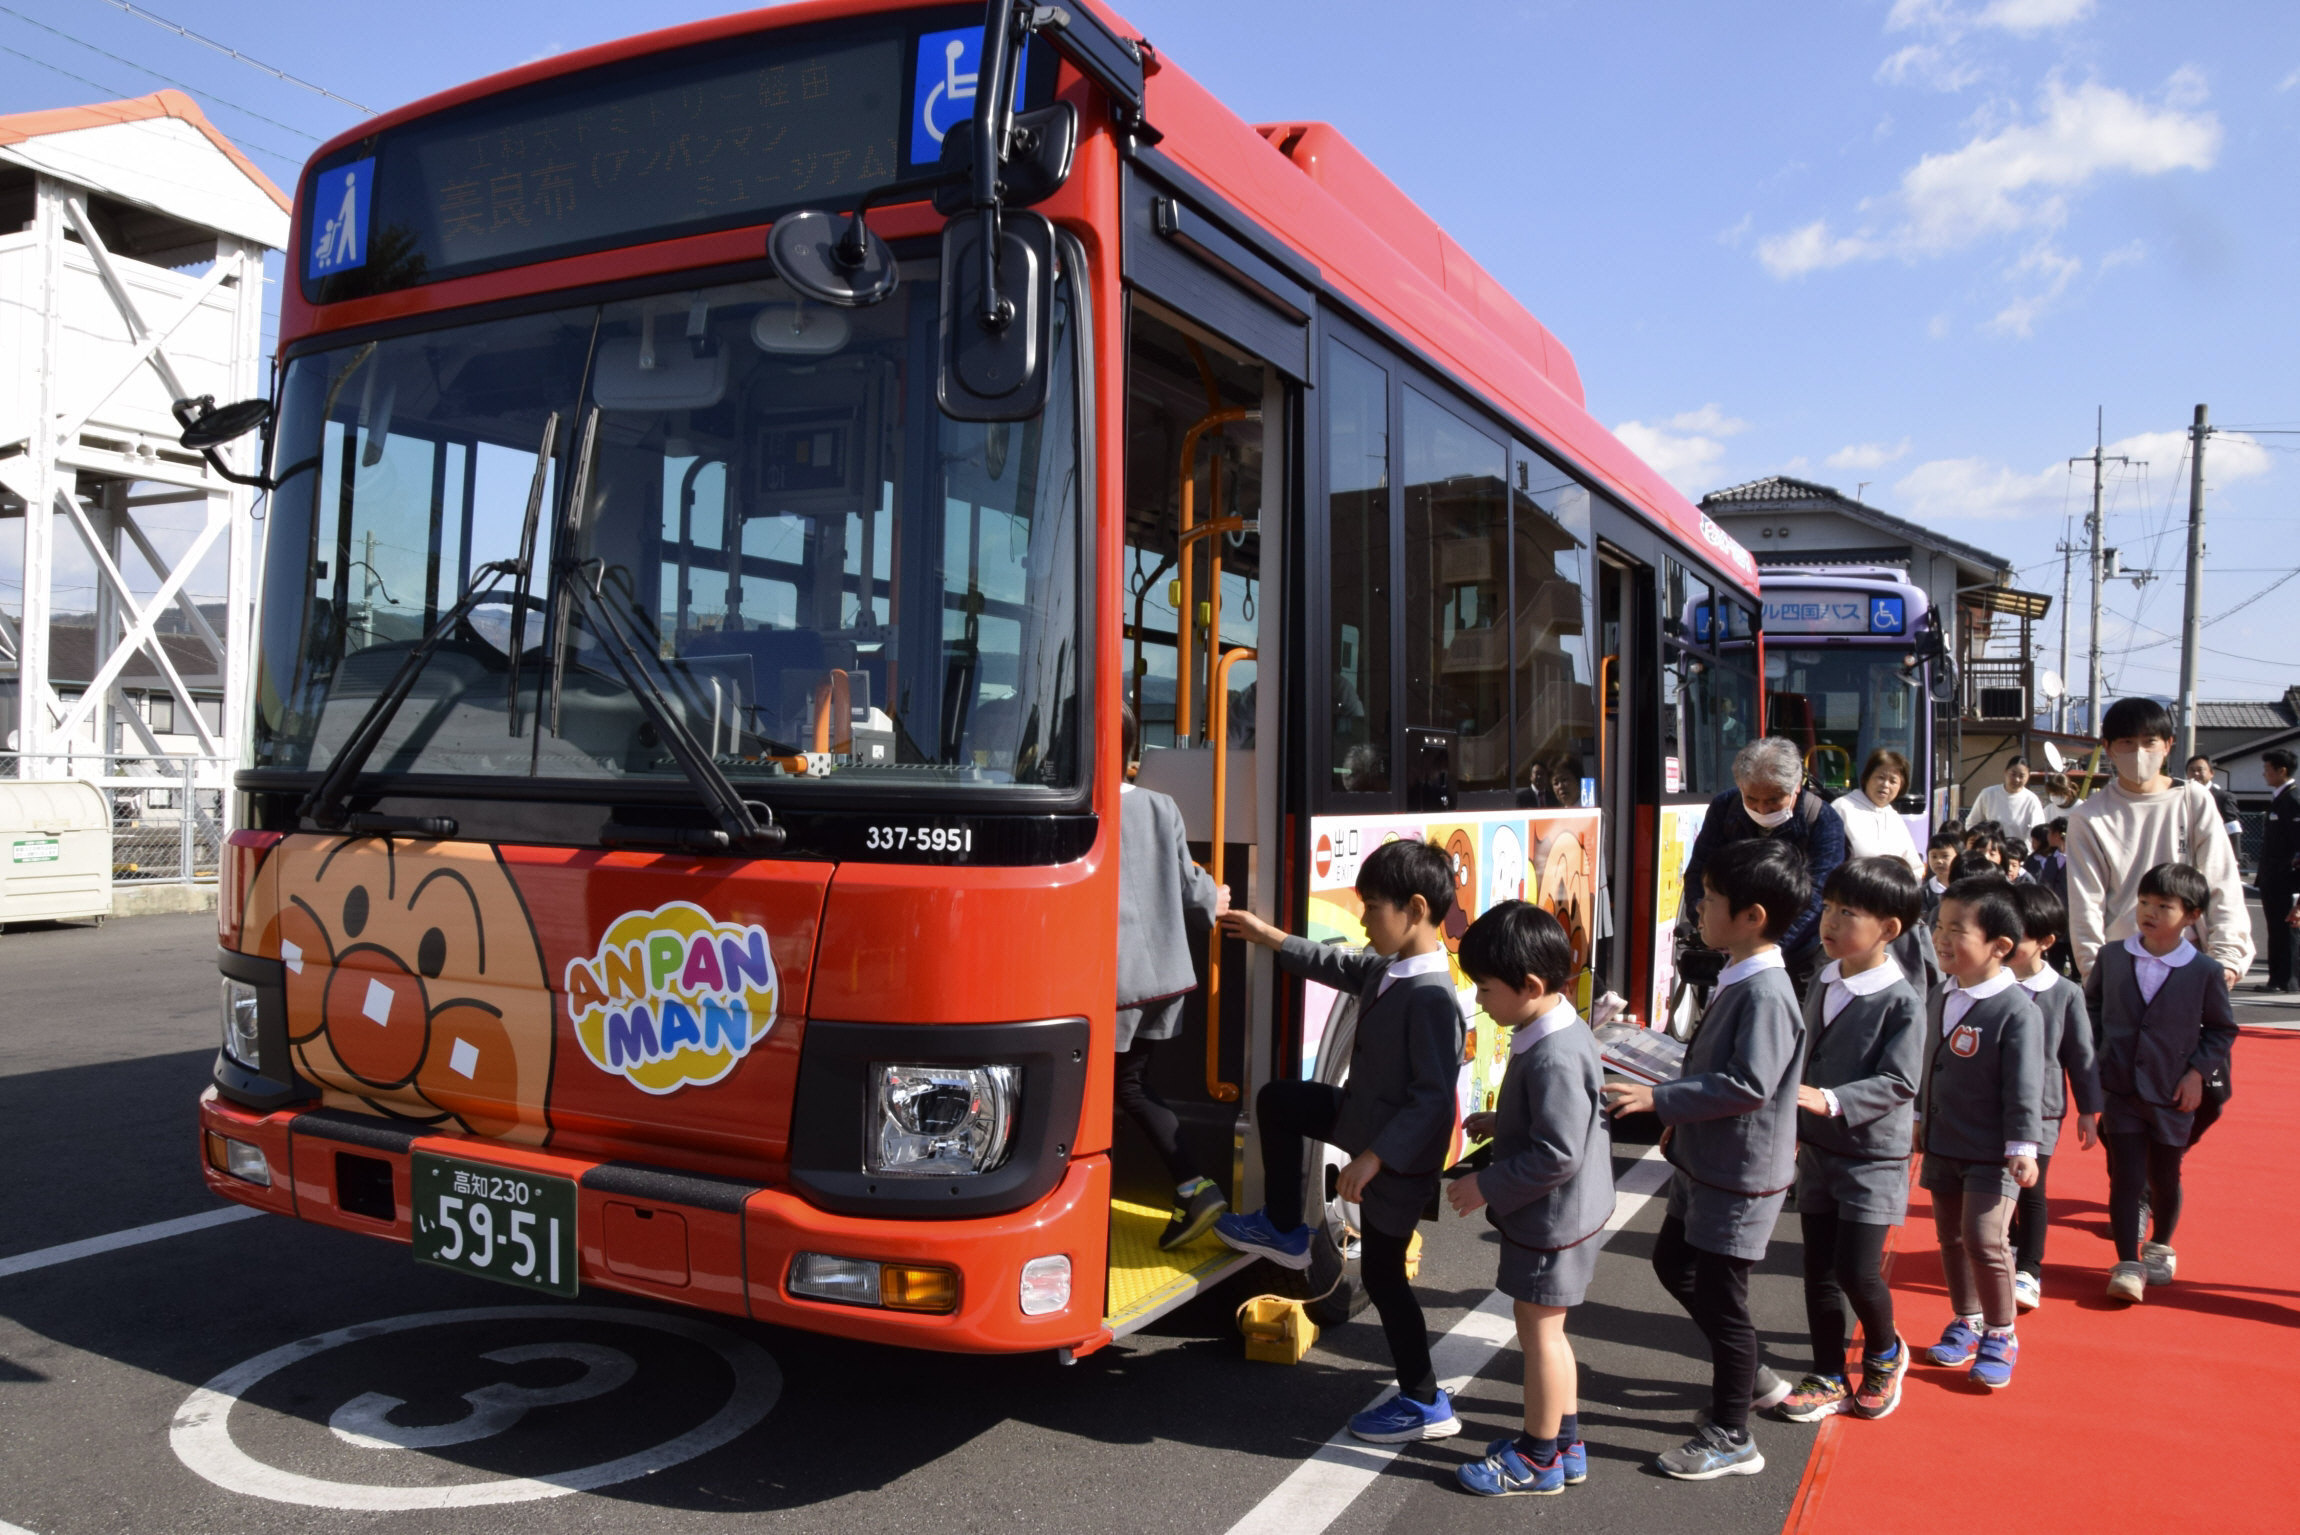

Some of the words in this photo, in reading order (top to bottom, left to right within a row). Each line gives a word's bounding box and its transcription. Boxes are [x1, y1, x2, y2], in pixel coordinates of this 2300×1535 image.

[439, 159, 580, 242] 美良布
[866, 826, 972, 852] 337-5951
[1334, 828, 1358, 857] 出口
[1336, 864, 1354, 881] EXIT
[569, 931, 769, 1016] ANPAN
[608, 997, 748, 1067] MAN
[419, 1214, 436, 1233] い
[440, 1195, 560, 1285] 59-51
[329, 1342, 638, 1449] 3
